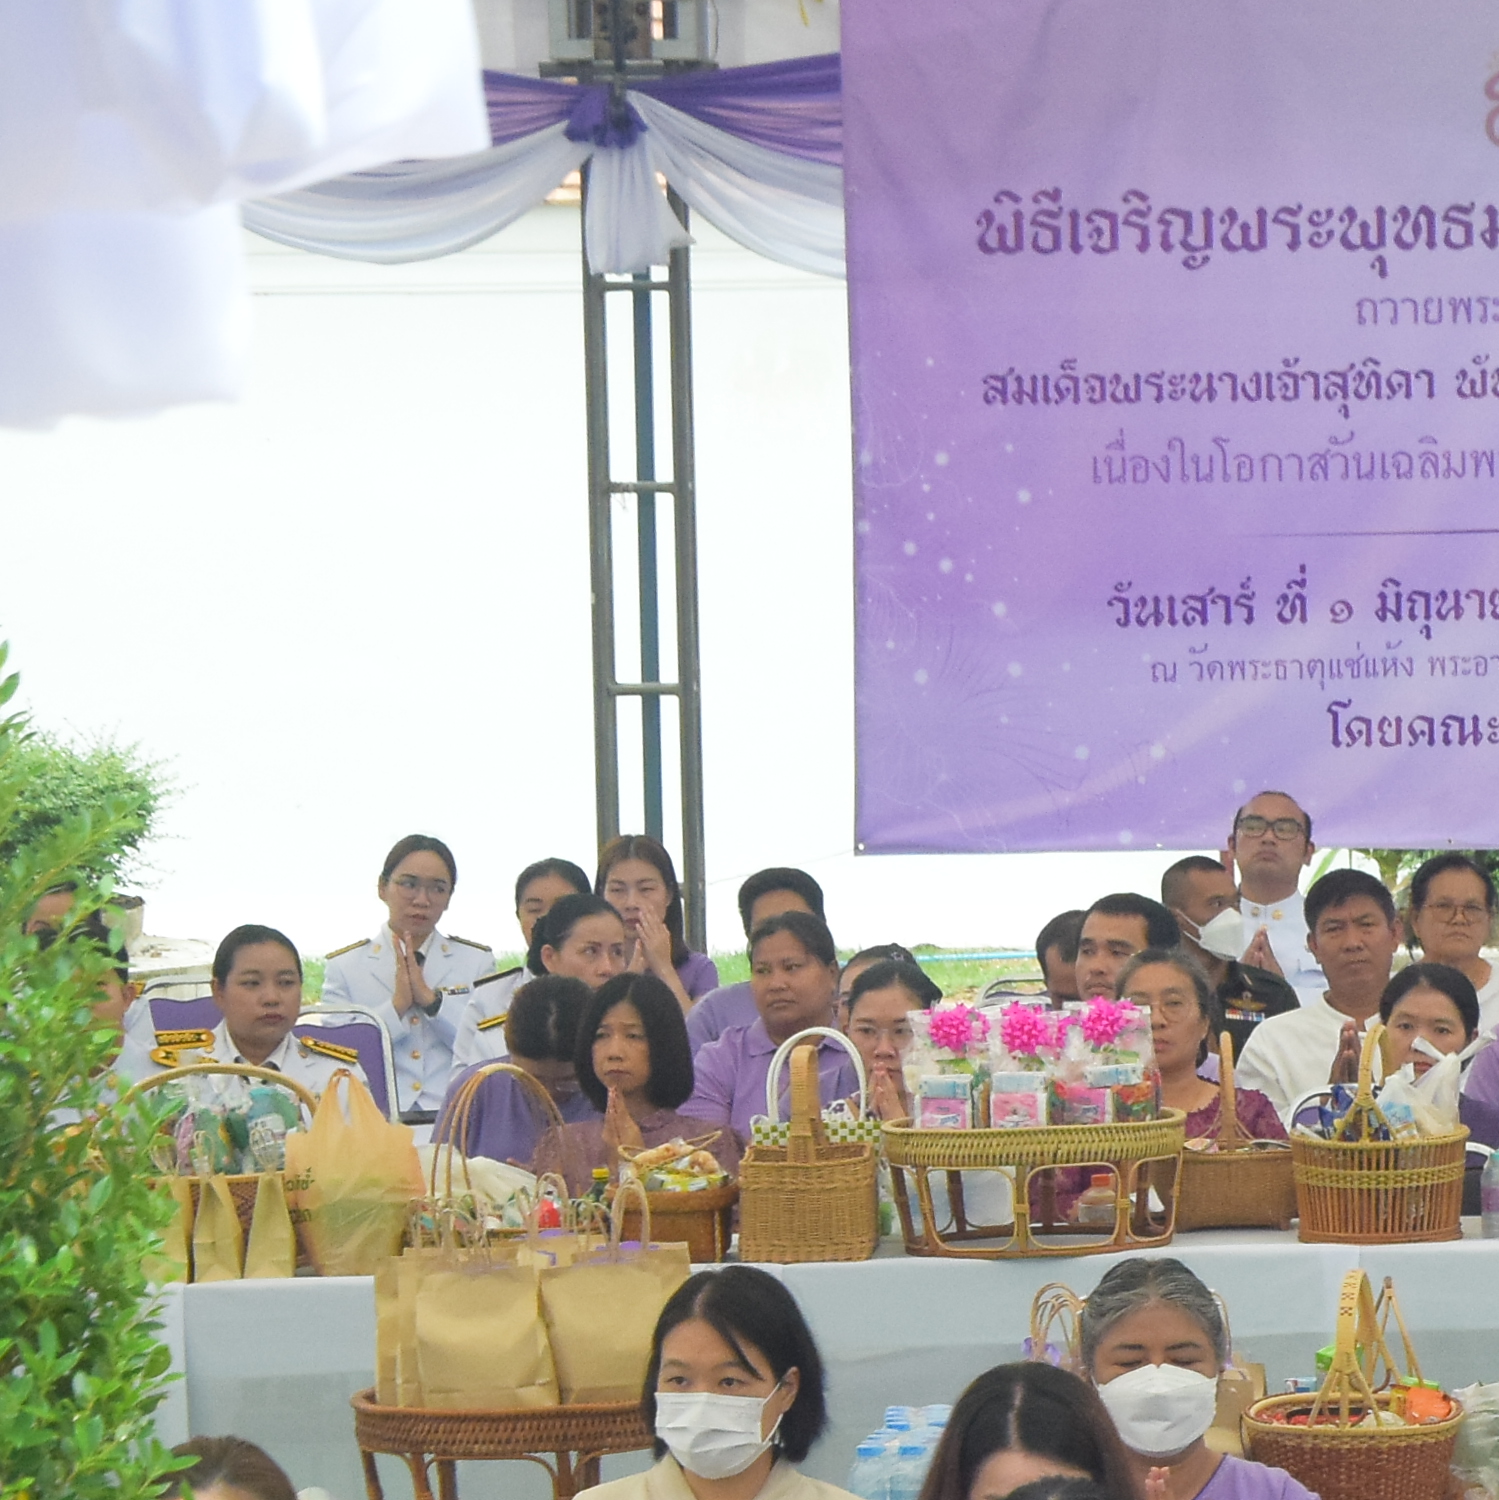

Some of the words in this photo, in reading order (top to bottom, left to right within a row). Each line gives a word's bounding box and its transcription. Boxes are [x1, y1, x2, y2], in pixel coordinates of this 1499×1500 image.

[982, 357, 1435, 418] สมเด็จพระนางเจ้าสุทิดา
[1107, 575, 1256, 628] วันเสาร์
[1276, 563, 1309, 625] ที่
[1329, 598, 1355, 624] ๑
[1150, 658, 1178, 683] ณ
[1189, 642, 1415, 690] วัดพระธาตุแช่แห้ง
